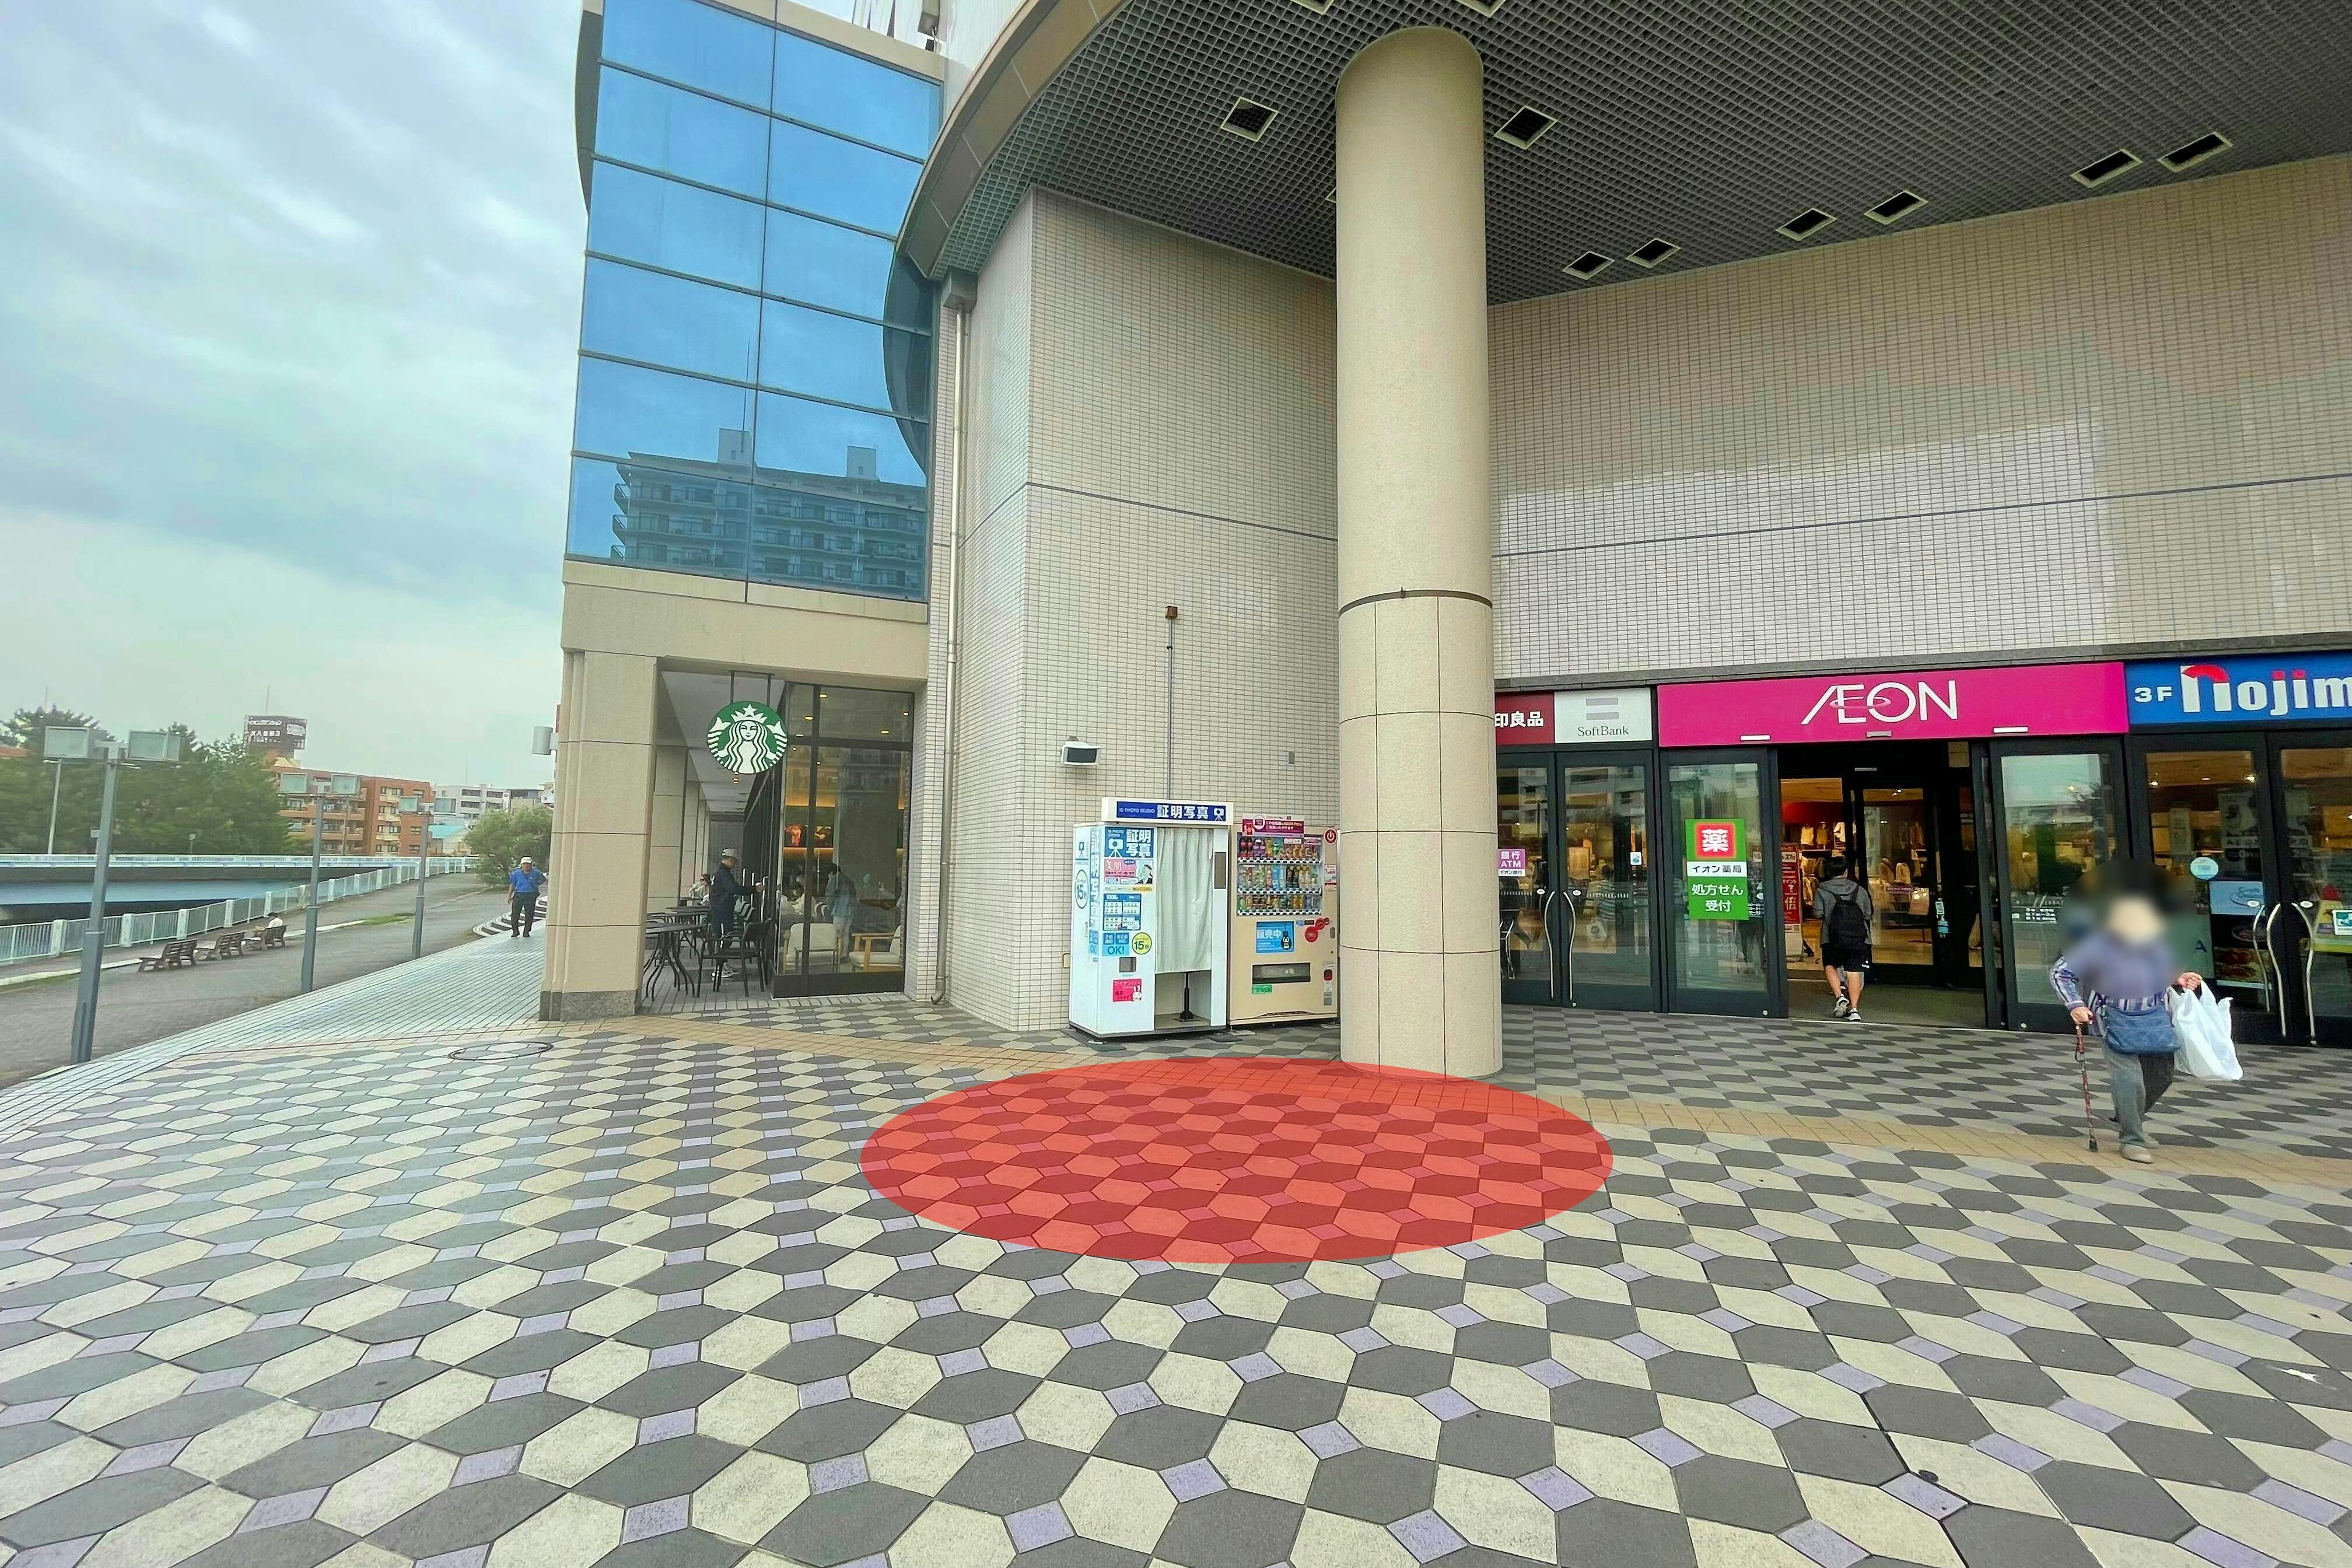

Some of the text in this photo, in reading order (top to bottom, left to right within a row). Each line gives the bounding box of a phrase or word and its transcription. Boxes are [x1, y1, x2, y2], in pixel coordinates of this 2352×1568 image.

[1577, 725, 1629, 737] SoftBank
[1157, 804, 1209, 820] 証明写真
[1126, 829, 1151, 844] 証明
[1701, 828, 1729, 853] 薬
[1126, 843, 1151, 858] 写真
[1692, 865, 1741, 873] イオン薬局
[1691, 884, 1744, 896] 処方せん
[1705, 900, 1731, 912] 受付
[1107, 946, 1125, 955] OK!
